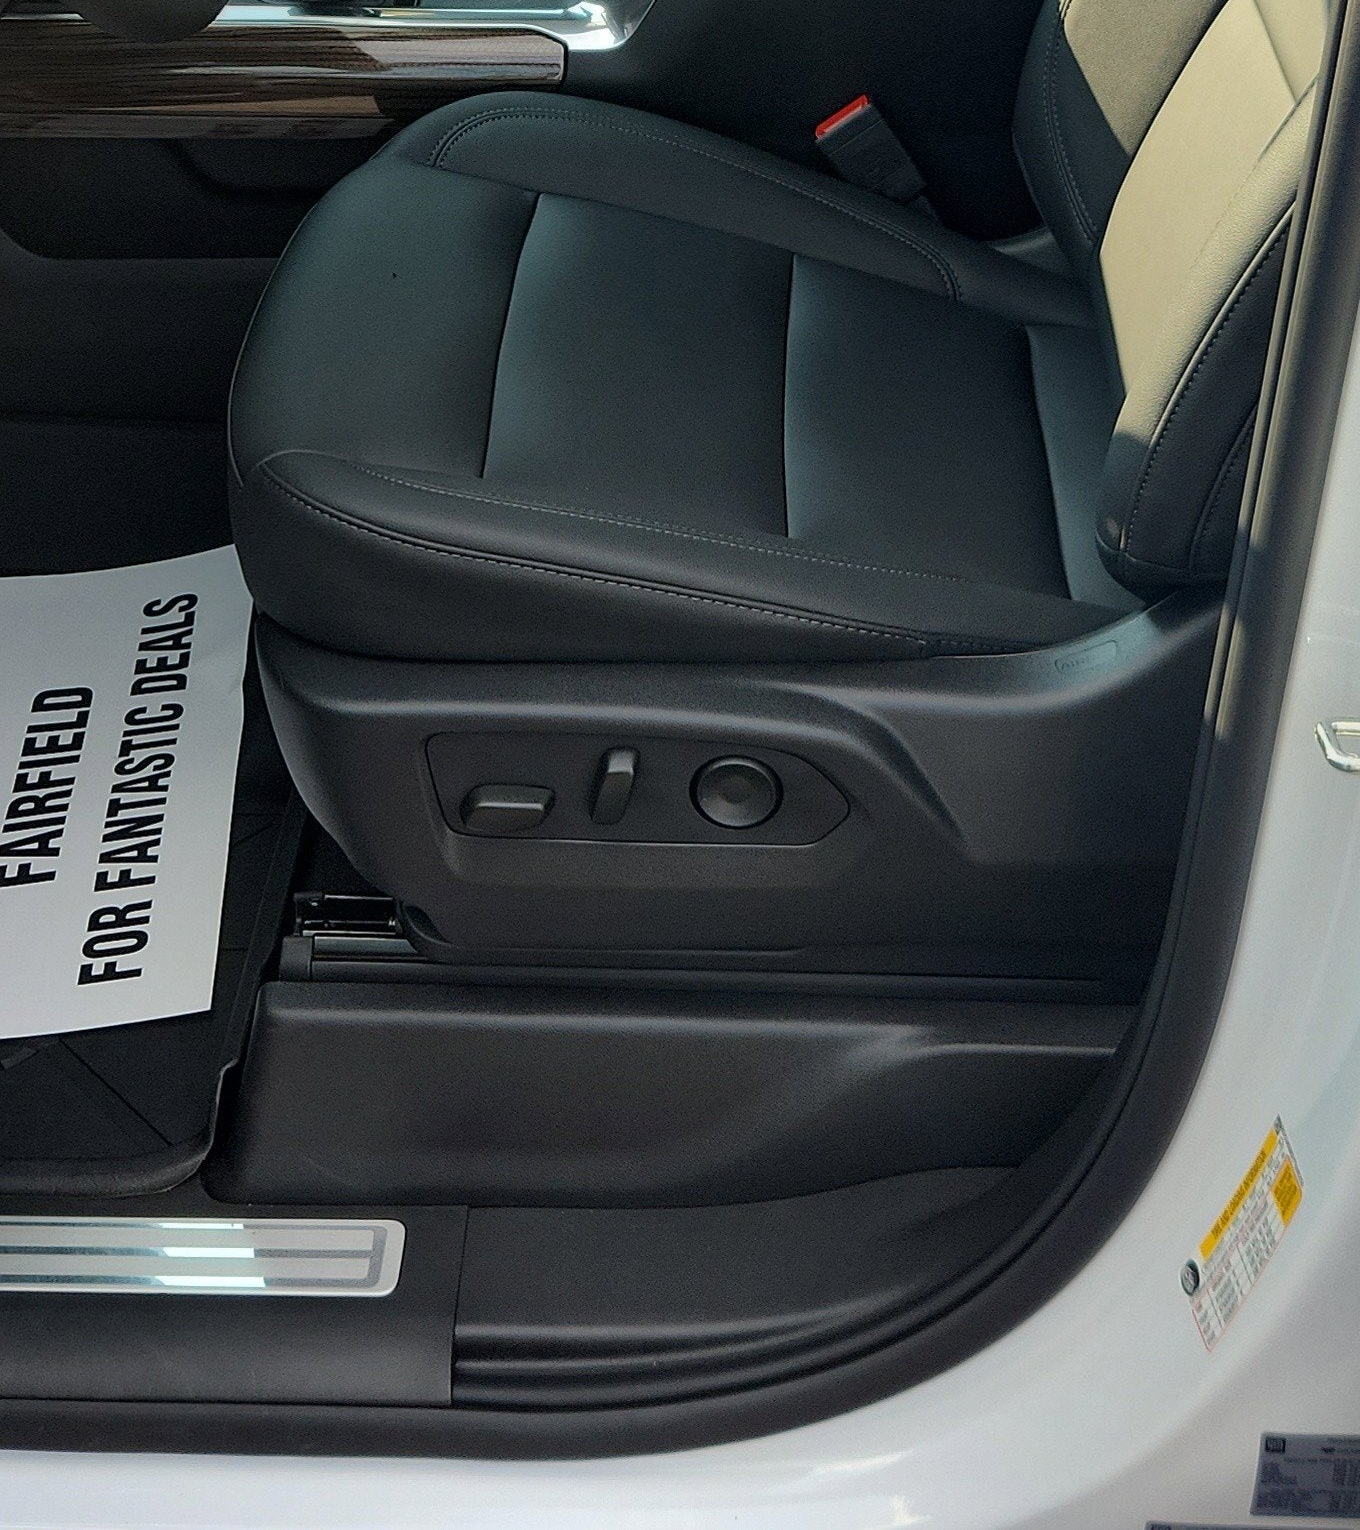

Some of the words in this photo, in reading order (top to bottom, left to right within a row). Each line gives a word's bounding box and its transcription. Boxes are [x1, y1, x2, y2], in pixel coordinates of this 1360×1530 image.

[130, 593, 199, 696] DEALS
[93, 702, 184, 892] FANTASTIC
[77, 899, 153, 985] FOR
